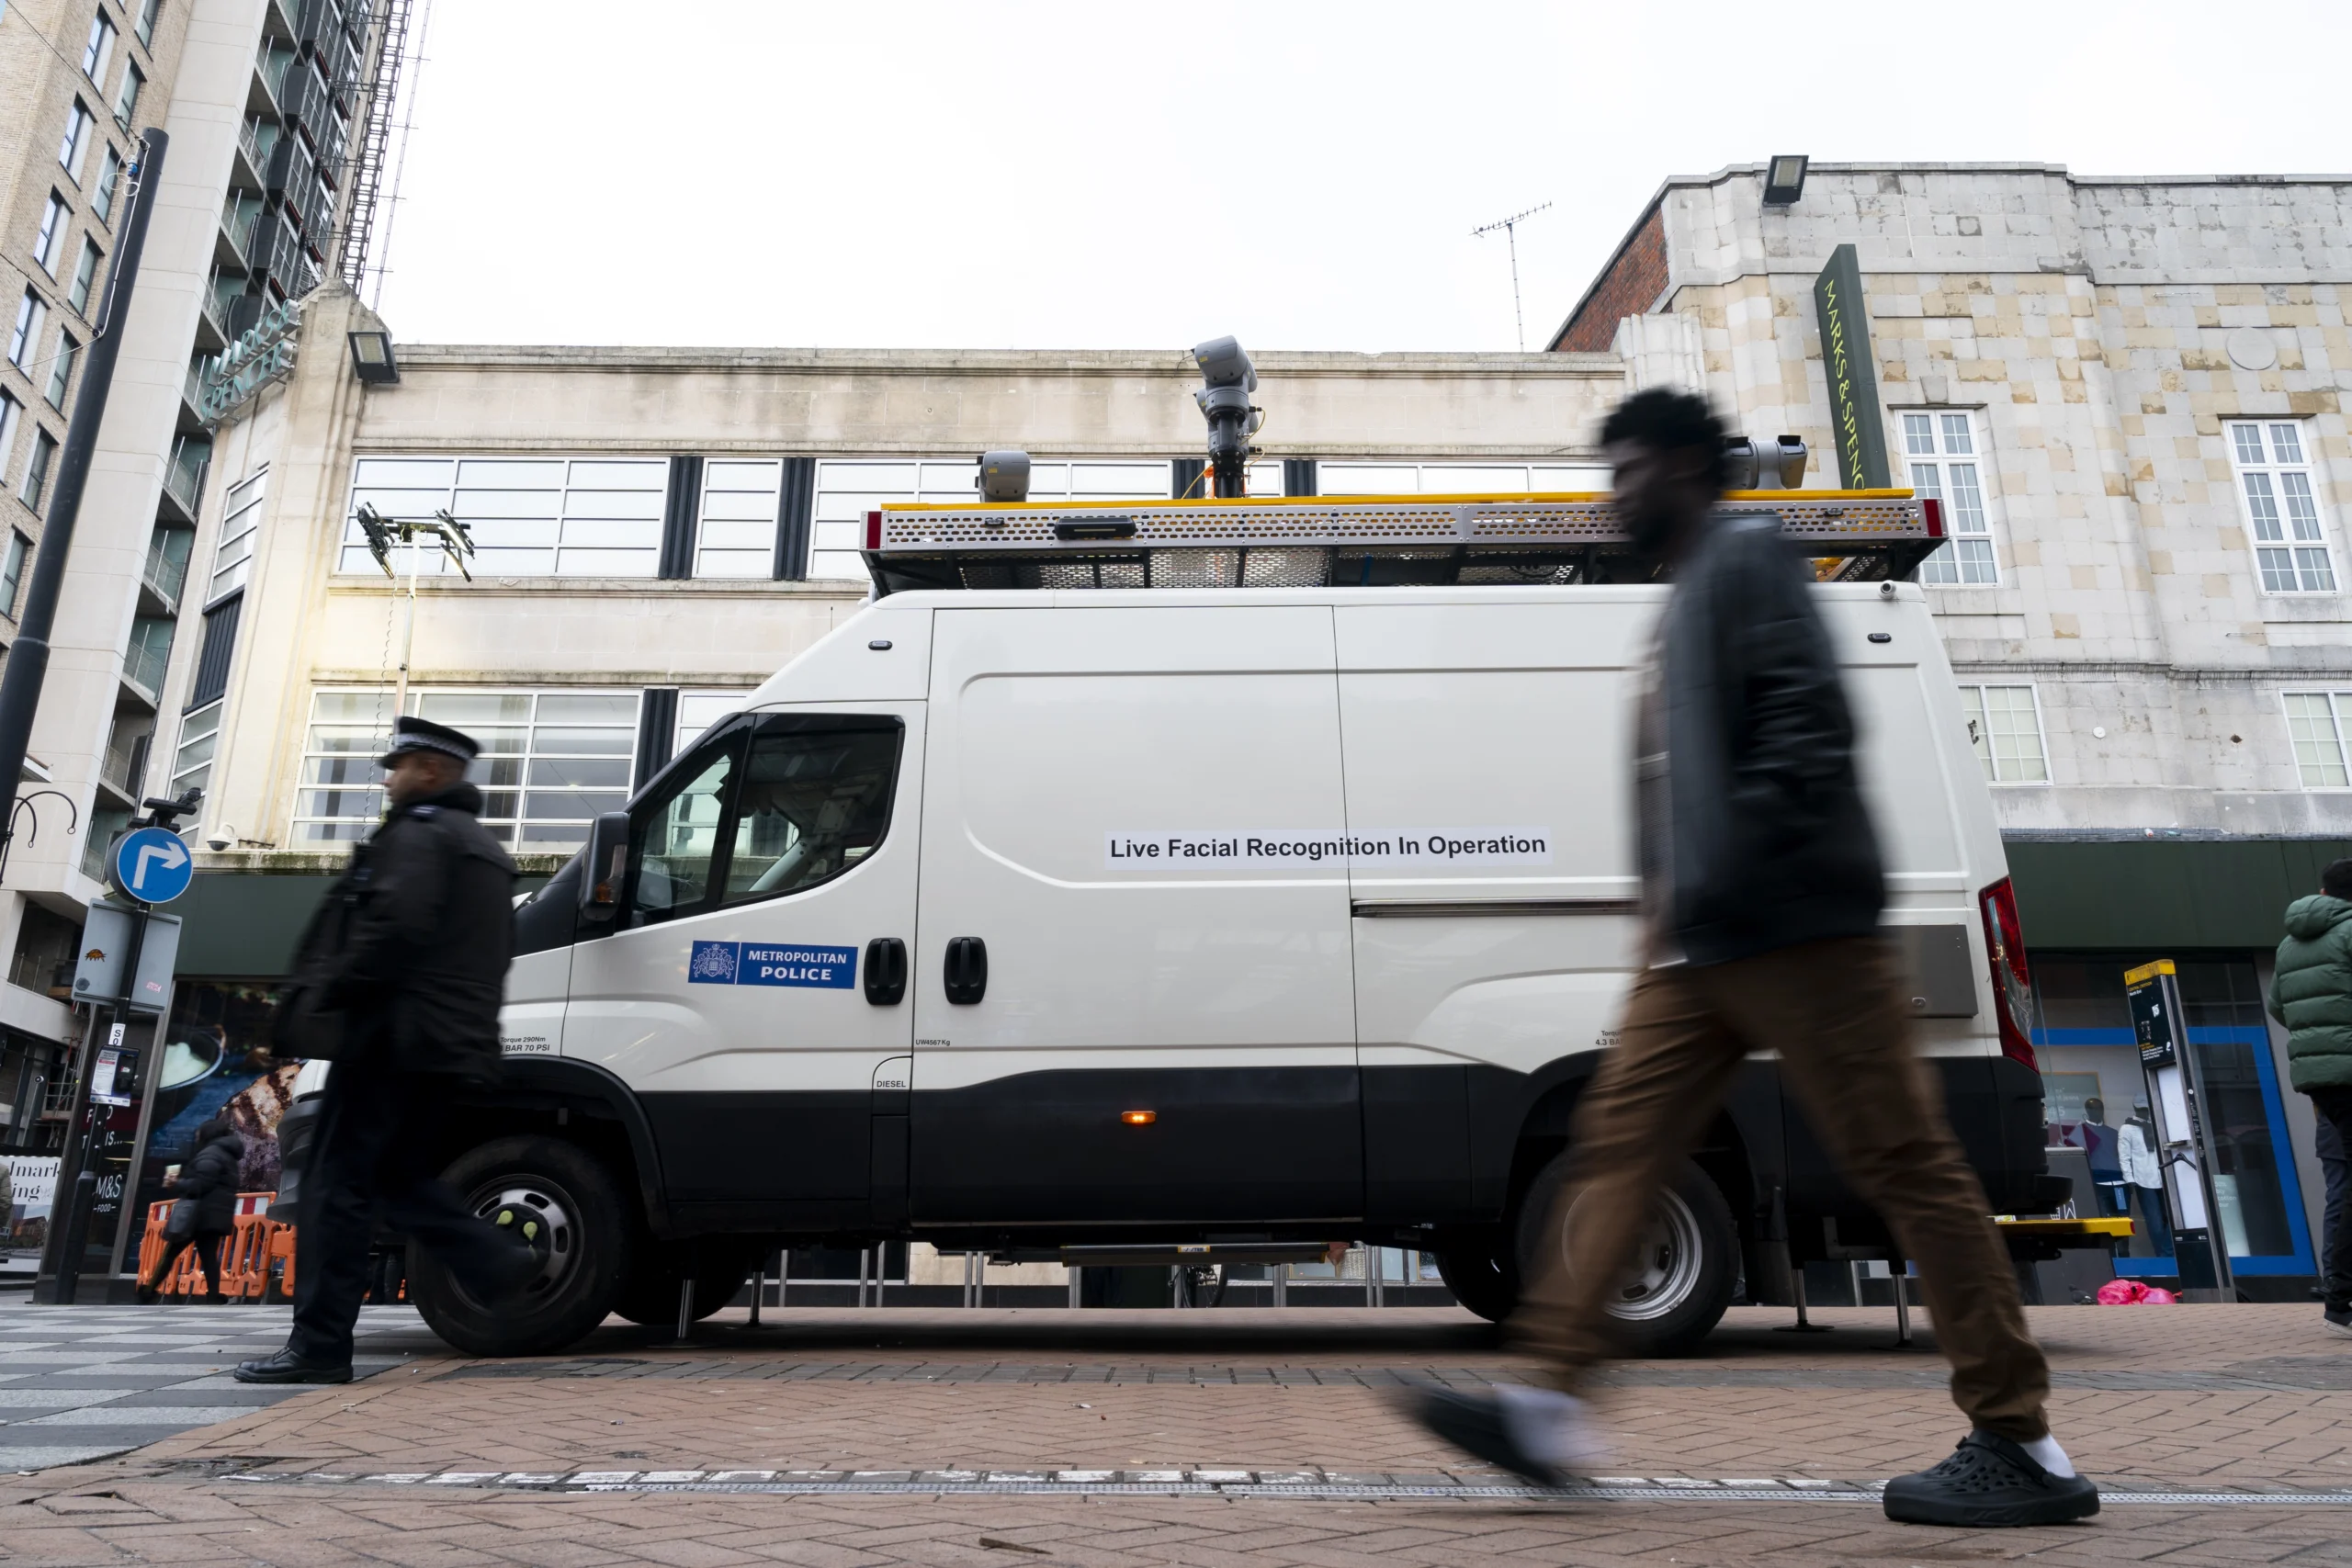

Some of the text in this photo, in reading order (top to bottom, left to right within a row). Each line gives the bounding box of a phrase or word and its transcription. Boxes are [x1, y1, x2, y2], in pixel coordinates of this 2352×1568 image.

[208, 309, 283, 387] MARKS
[1825, 278, 1848, 379] MARKS
[1839, 379, 1850, 403] &
[198, 339, 293, 426] SPENCER
[1110, 834, 1547, 861] Live Facial Recognition In Operation
[747, 949, 847, 964] METROPOLITAN
[760, 965, 832, 981] POLICE
[501, 1035, 547, 1044] Torque 290Nm
[536, 1043, 550, 1052] PSI
[96, 1173, 123, 1200] M&S
[96, 1203, 111, 1213] FOOD
